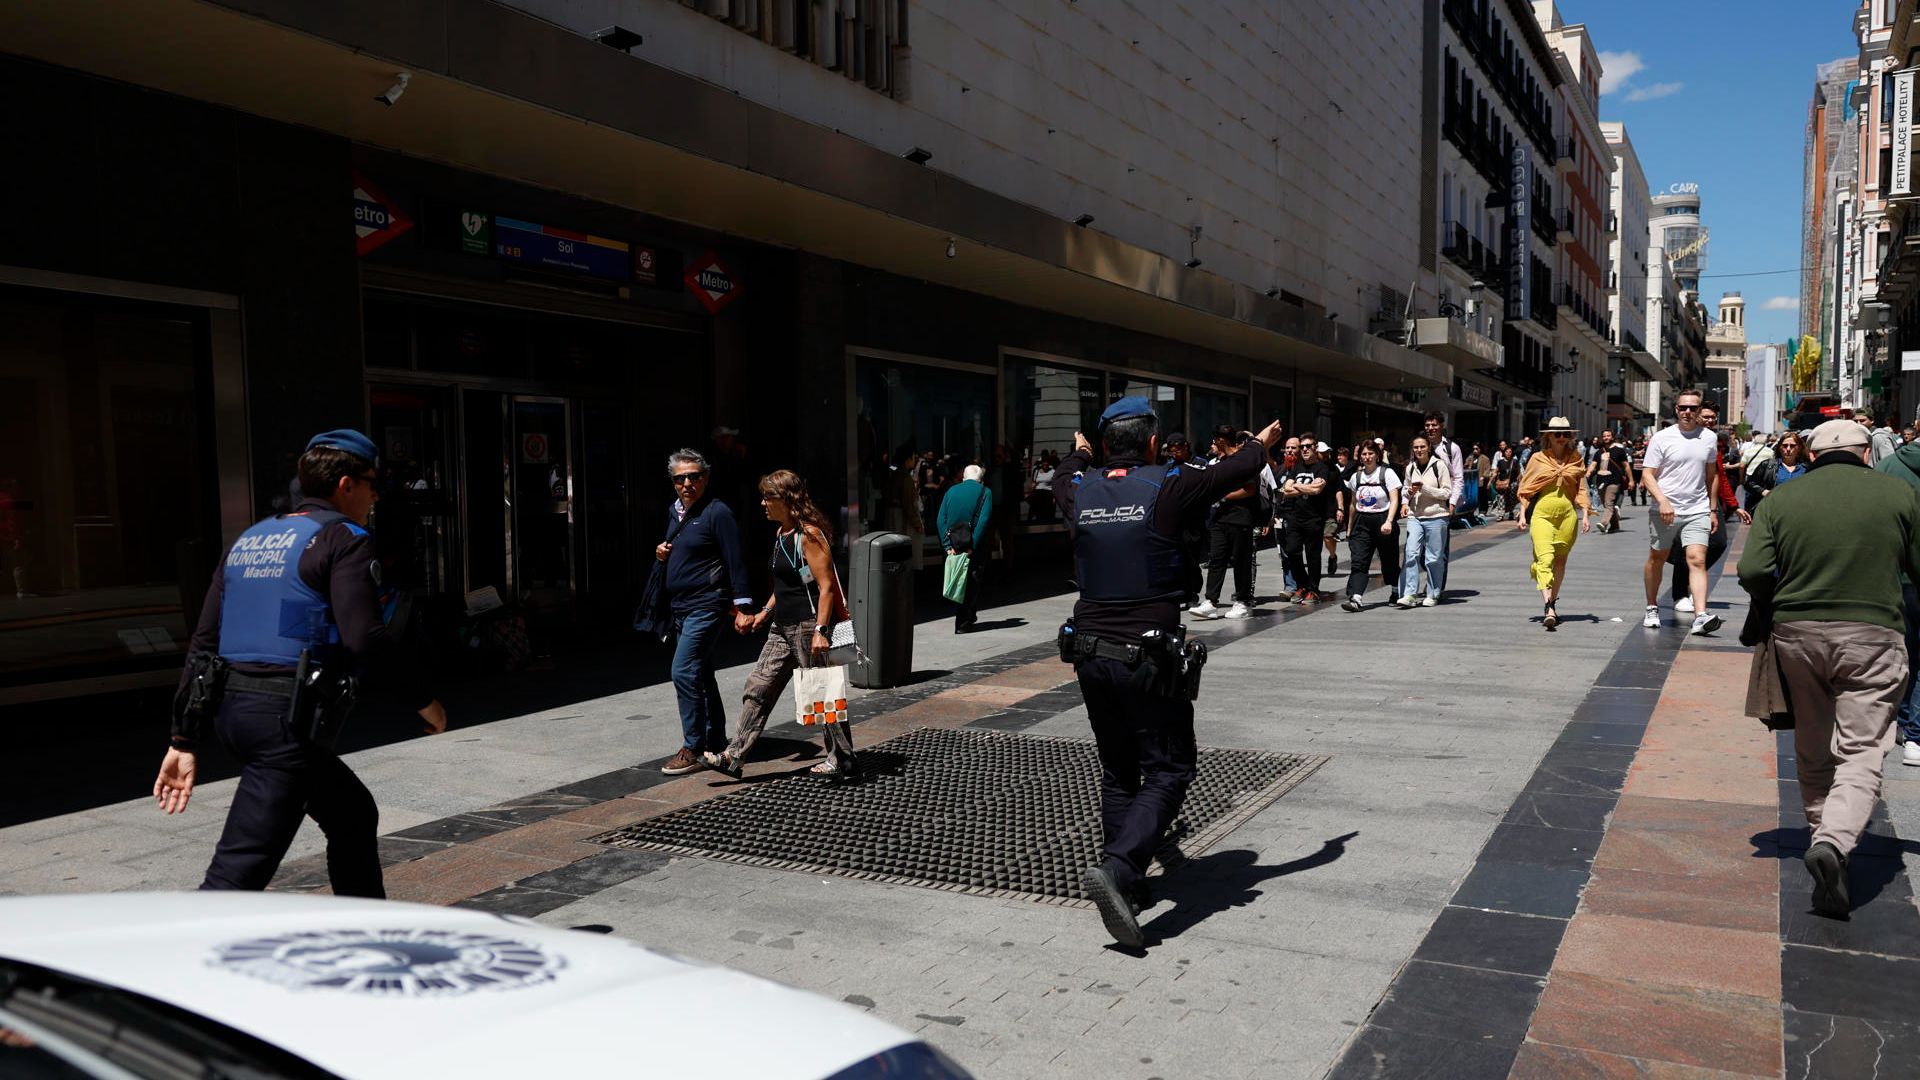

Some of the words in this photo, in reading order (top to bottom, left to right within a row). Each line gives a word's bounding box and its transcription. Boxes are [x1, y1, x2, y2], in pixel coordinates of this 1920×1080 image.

[1899, 80, 1909, 123] HOTELITY
[1896, 126, 1907, 189] PETITPALACE
[354, 205, 385, 224] etro
[557, 240, 574, 254] Sol
[702, 272, 729, 290] Metro
[231, 528, 297, 552] POLICÍA
[226, 549, 287, 567] MUNICIPAL
[243, 566, 285, 578] Madrid
